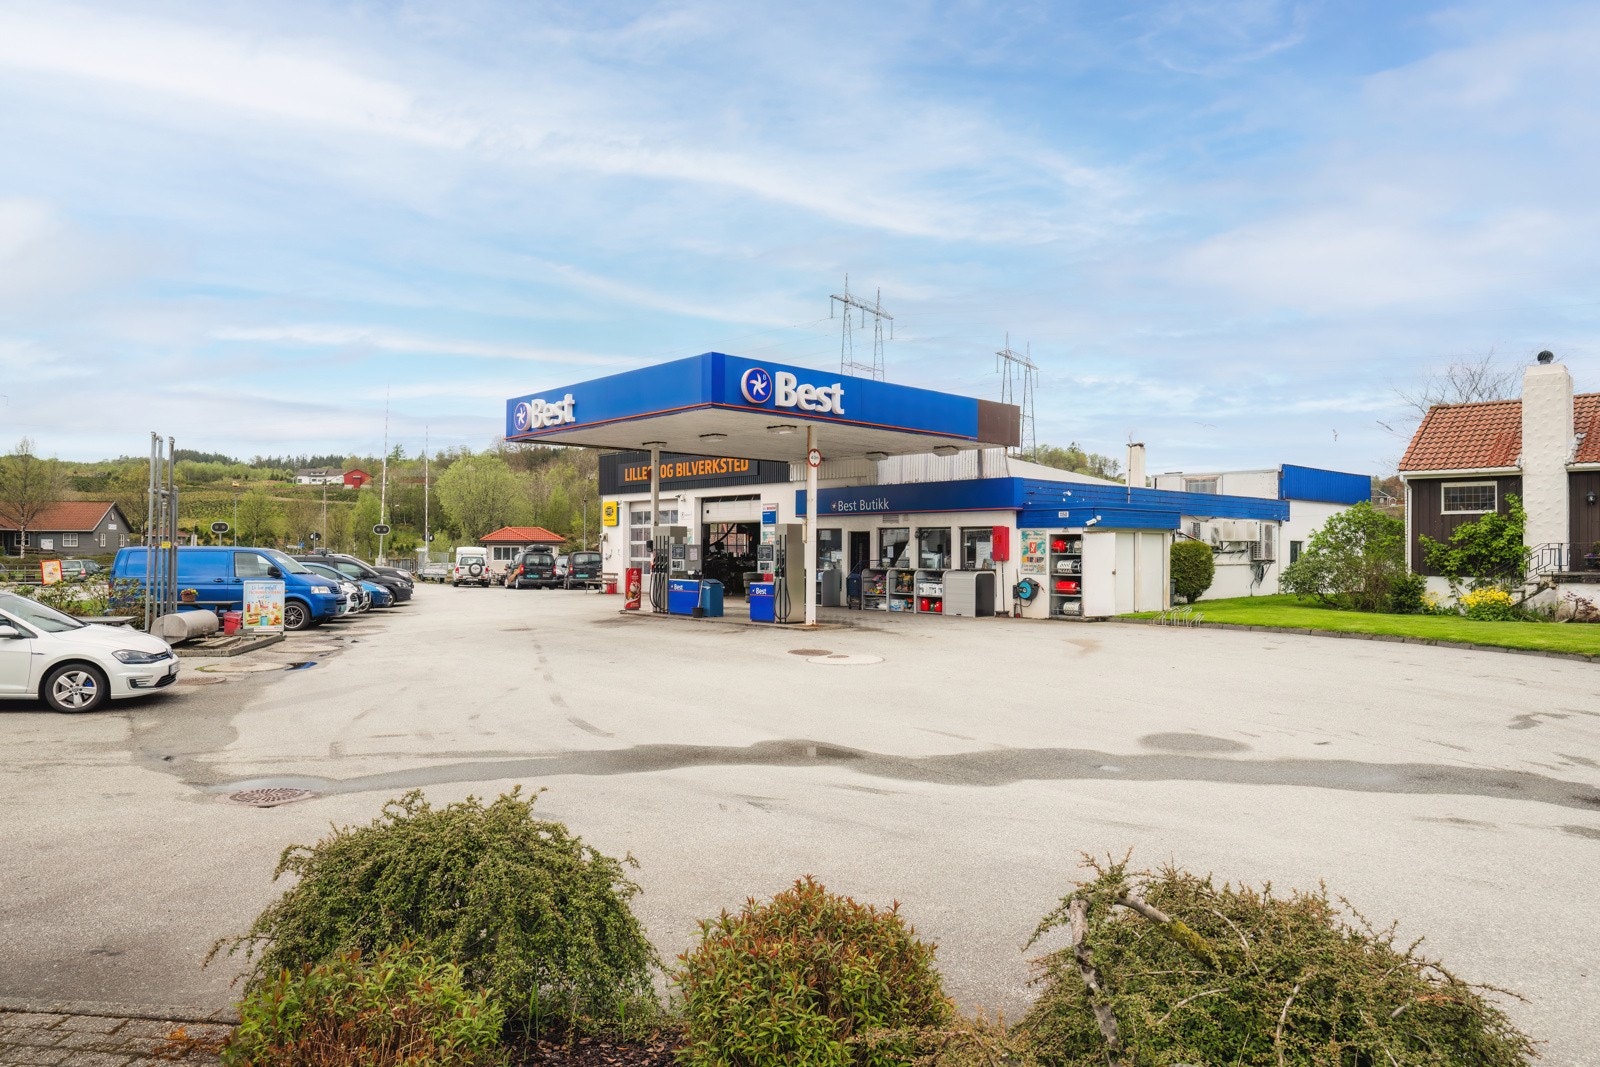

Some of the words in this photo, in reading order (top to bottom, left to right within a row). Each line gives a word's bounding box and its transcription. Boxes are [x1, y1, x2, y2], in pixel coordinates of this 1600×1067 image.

[775, 371, 845, 415] Best
[531, 393, 576, 429] Best
[676, 457, 749, 478] BILVERKSTED
[838, 500, 857, 512] Best
[859, 497, 890, 511] Butikk
[673, 583, 684, 591] Best
[755, 587, 767, 595] Best
